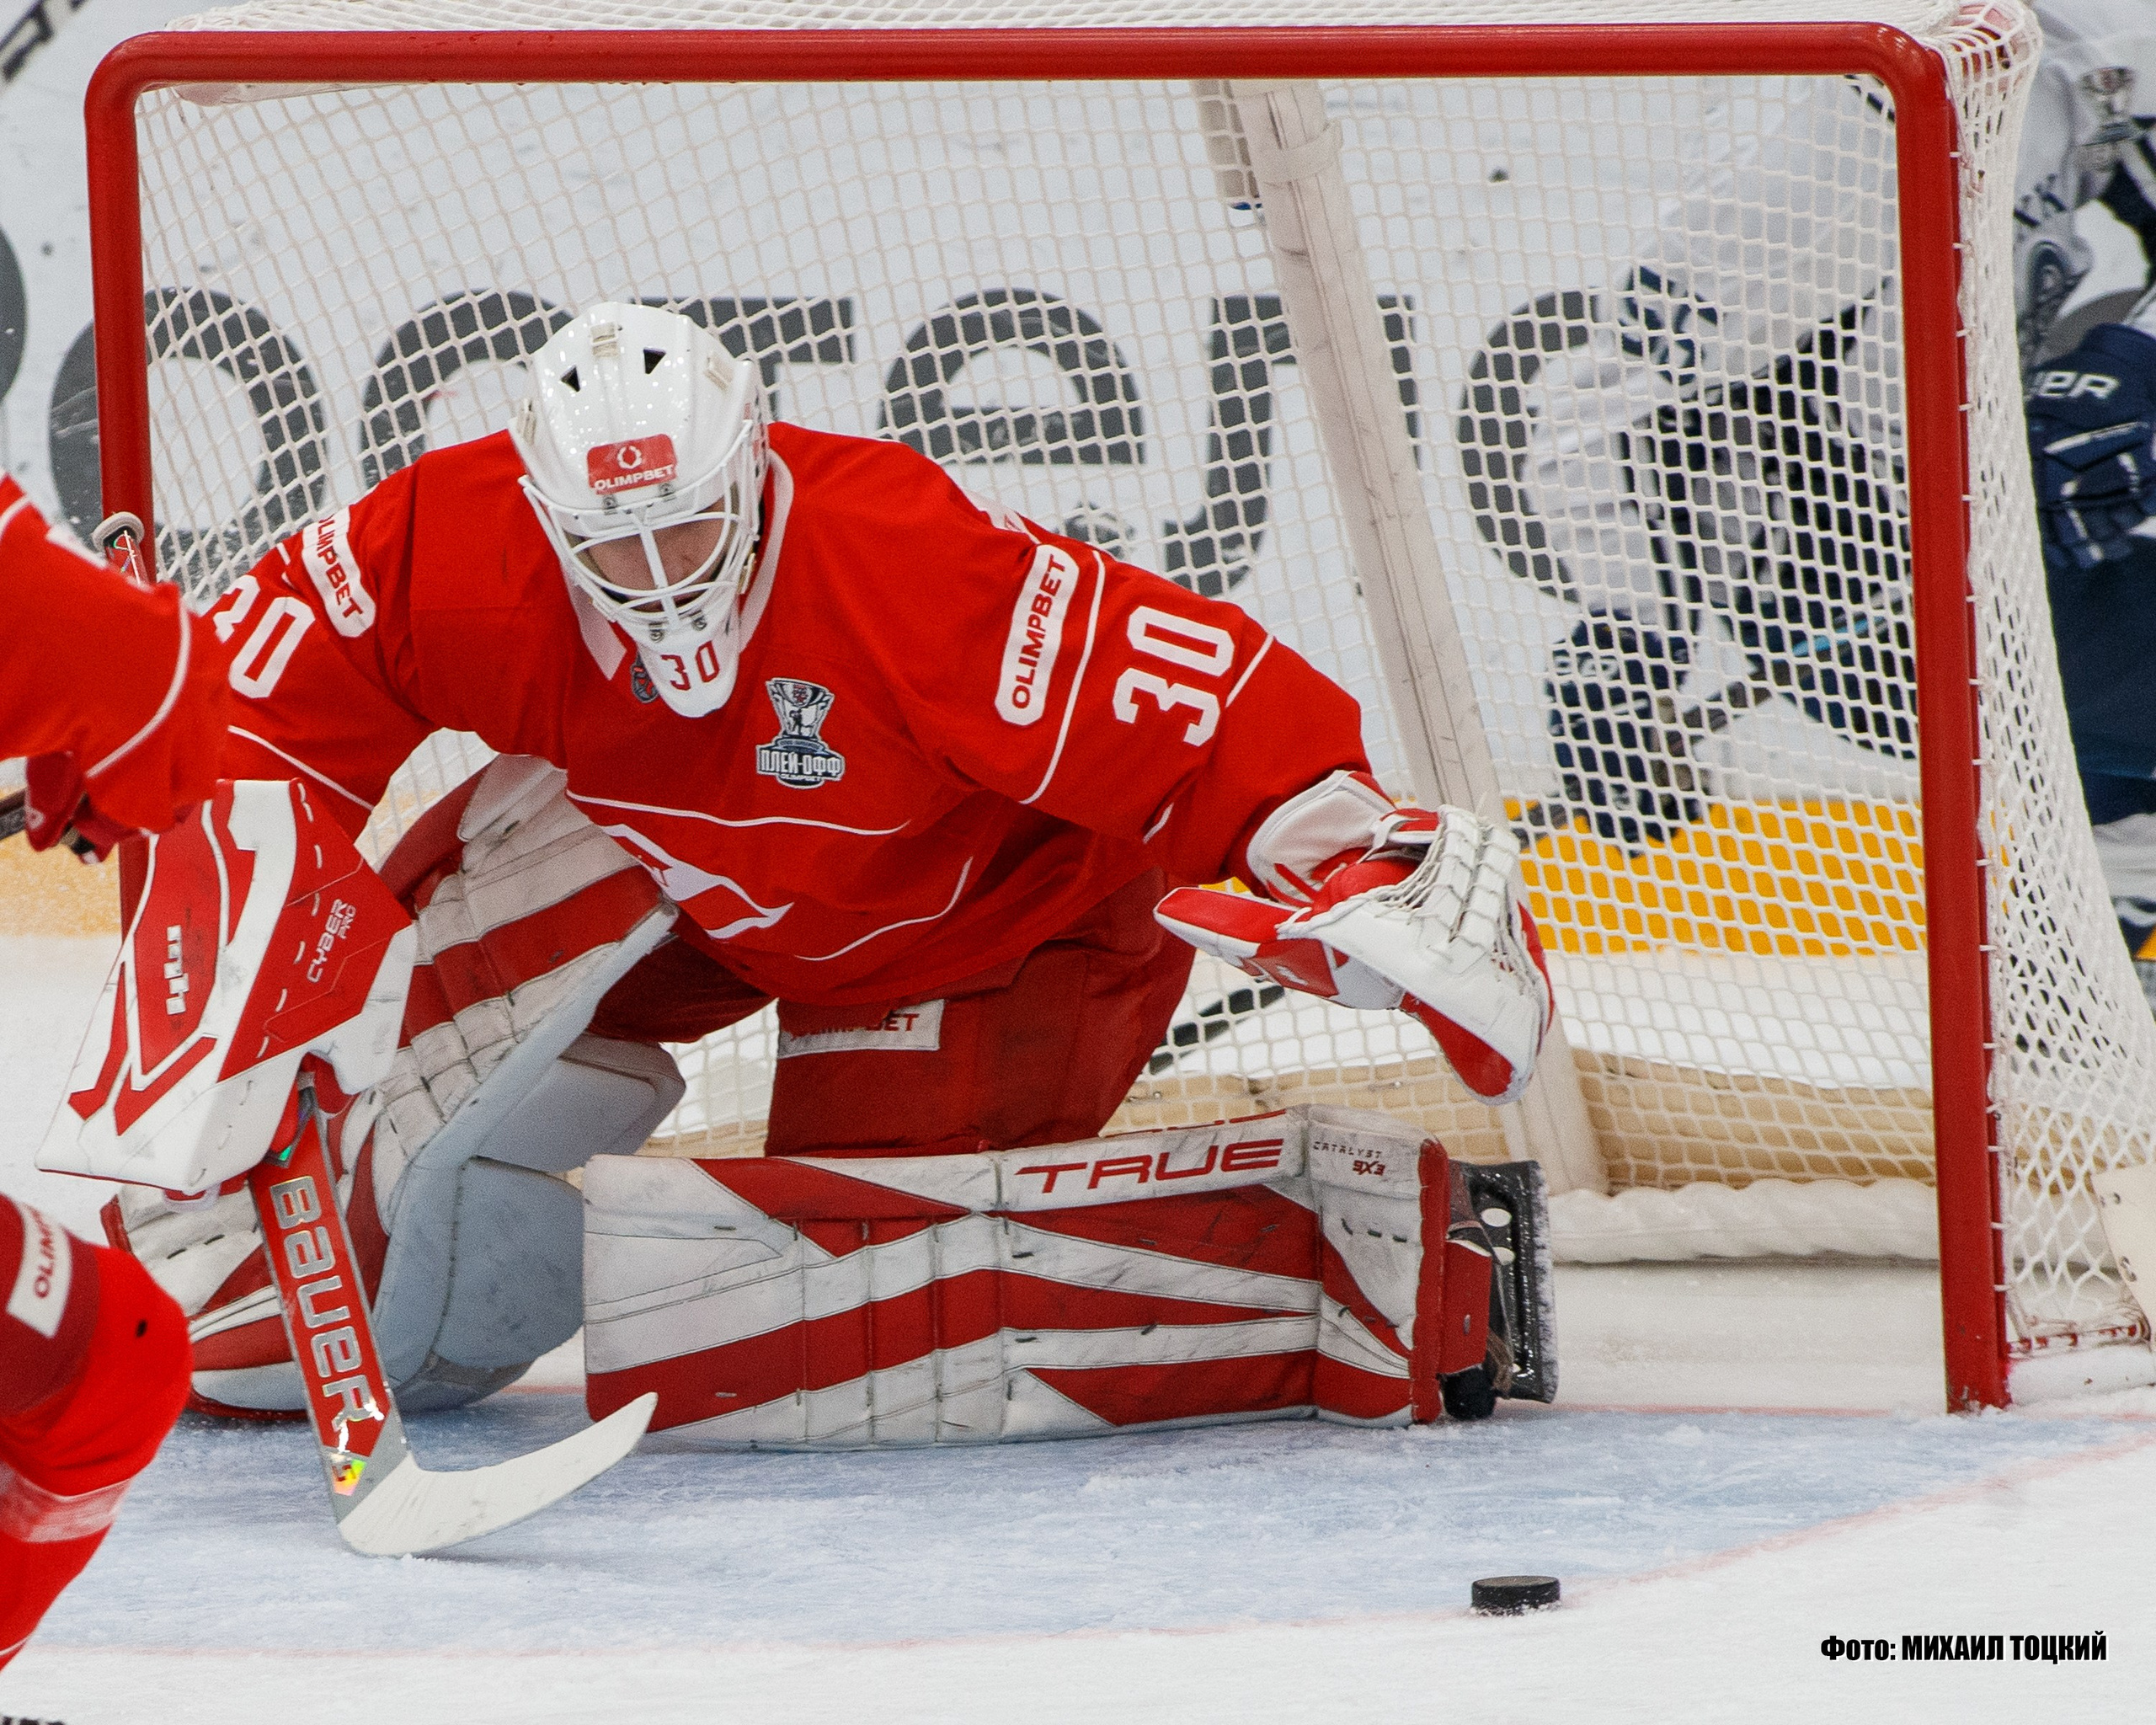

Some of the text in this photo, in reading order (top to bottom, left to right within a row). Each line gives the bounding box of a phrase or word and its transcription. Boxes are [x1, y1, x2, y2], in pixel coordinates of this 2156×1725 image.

[594, 464, 674, 491] OLIMPBET
[1012, 553, 1067, 710] OLIMPBET
[659, 640, 721, 692] 30
[1112, 605, 1235, 748] 30
[760, 749, 841, 777] ПЛЕЙ-ОФФ
[307, 899, 347, 984] CYBER
[337, 905, 356, 940] PRO
[1014, 1138, 1284, 1194] TRUE
[1313, 1140, 1383, 1159] CATALYST
